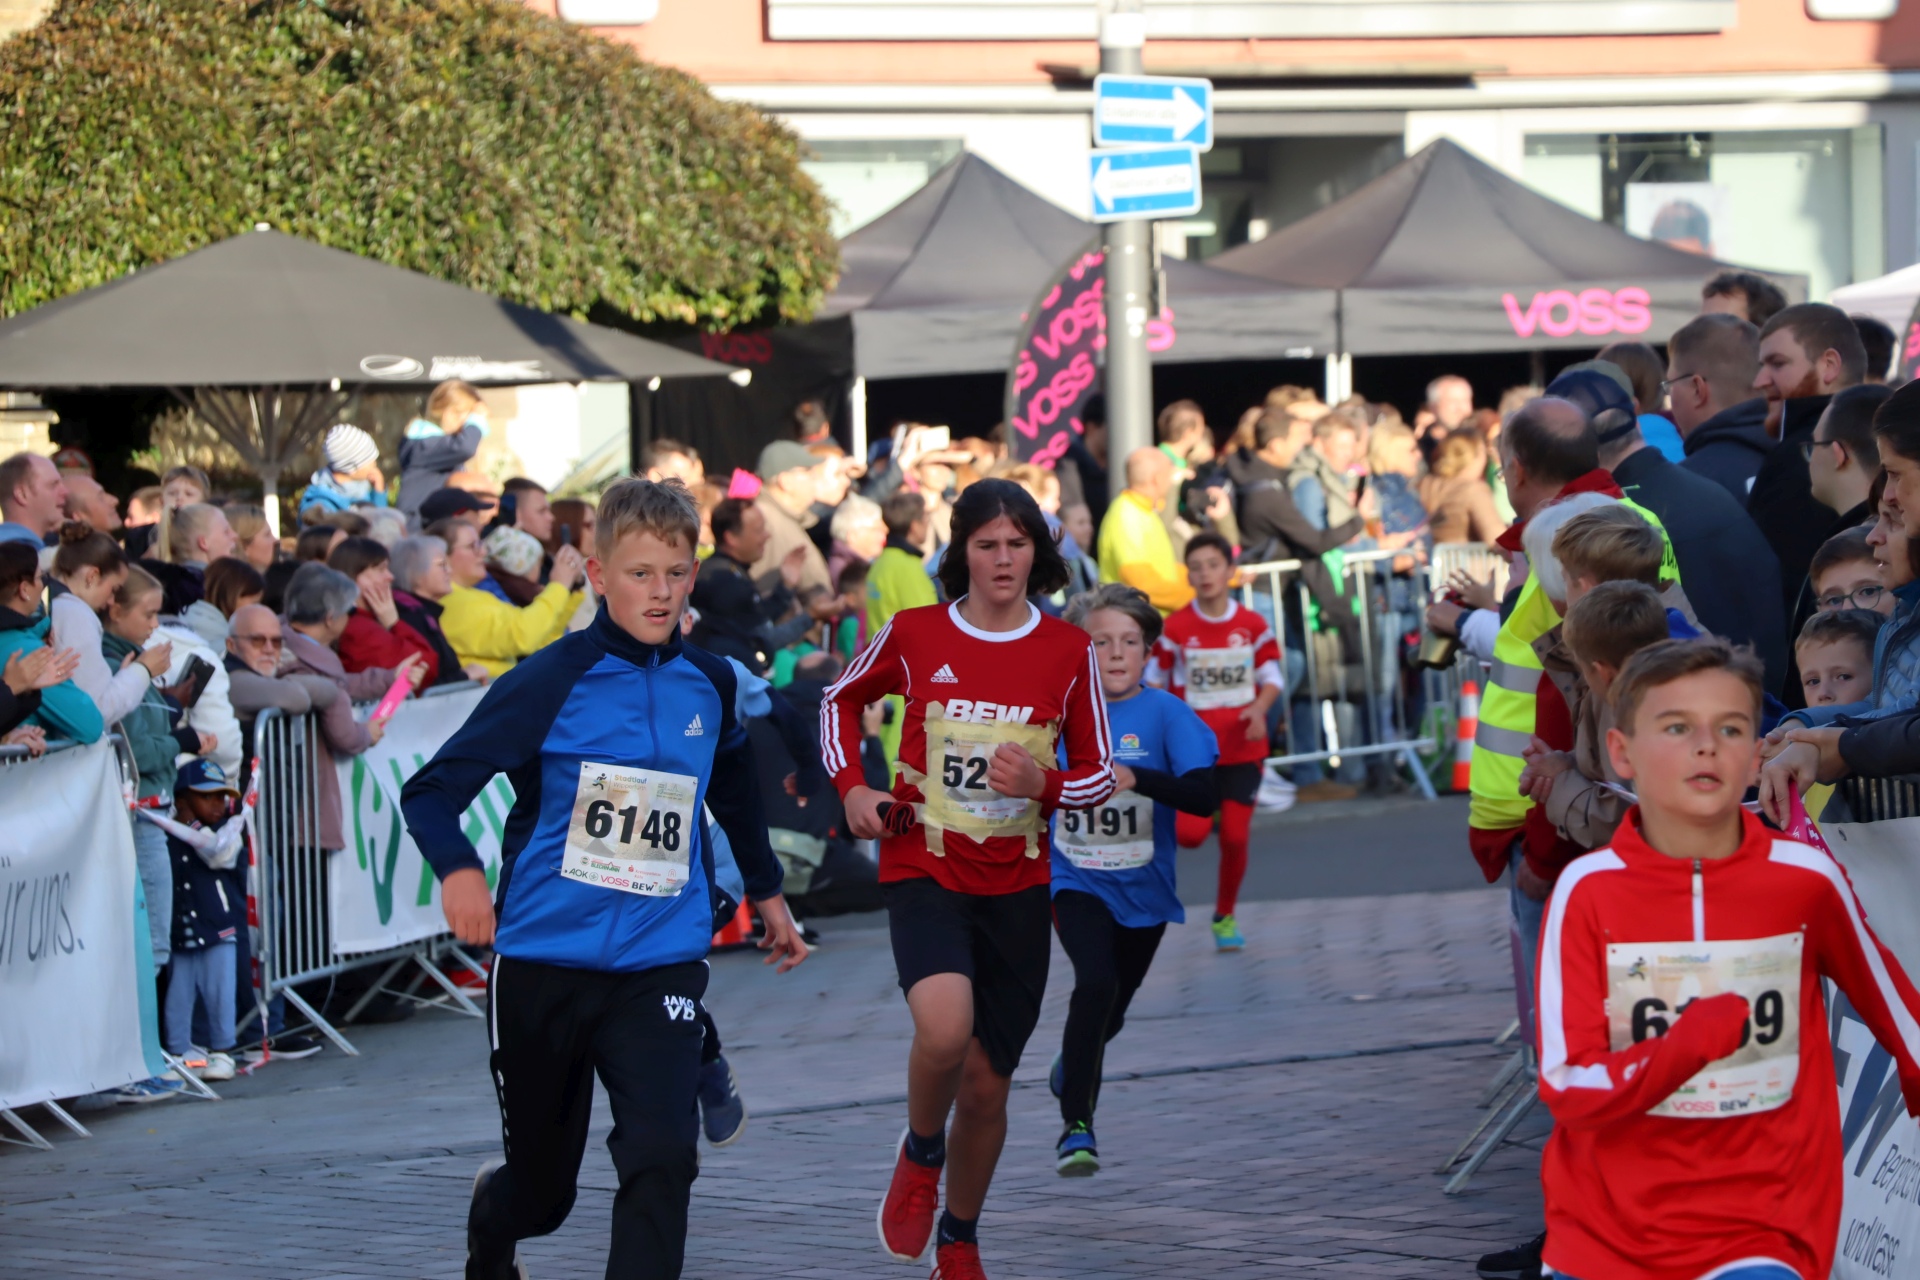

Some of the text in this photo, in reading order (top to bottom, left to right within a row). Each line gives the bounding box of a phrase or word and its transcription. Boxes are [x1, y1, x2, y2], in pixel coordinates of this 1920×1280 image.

[1501, 286, 1653, 338] VOSS
[1011, 352, 1096, 439] VOSS
[930, 675, 959, 684] adidas
[1191, 664, 1247, 687] 5562
[684, 728, 704, 737] adidas
[614, 774, 648, 785] Stadtlauf
[942, 754, 988, 790] 52
[585, 800, 682, 852] 6148
[1064, 805, 1137, 837] 5191
[568, 868, 588, 879] AOK
[600, 874, 630, 888] VOSS
[631, 881, 655, 892] BEW
[27, 871, 85, 962] uns.
[663, 994, 695, 1010] JAKO
[1631, 989, 1784, 1050] 69
[1671, 1098, 1751, 1113] VOSS BEW
